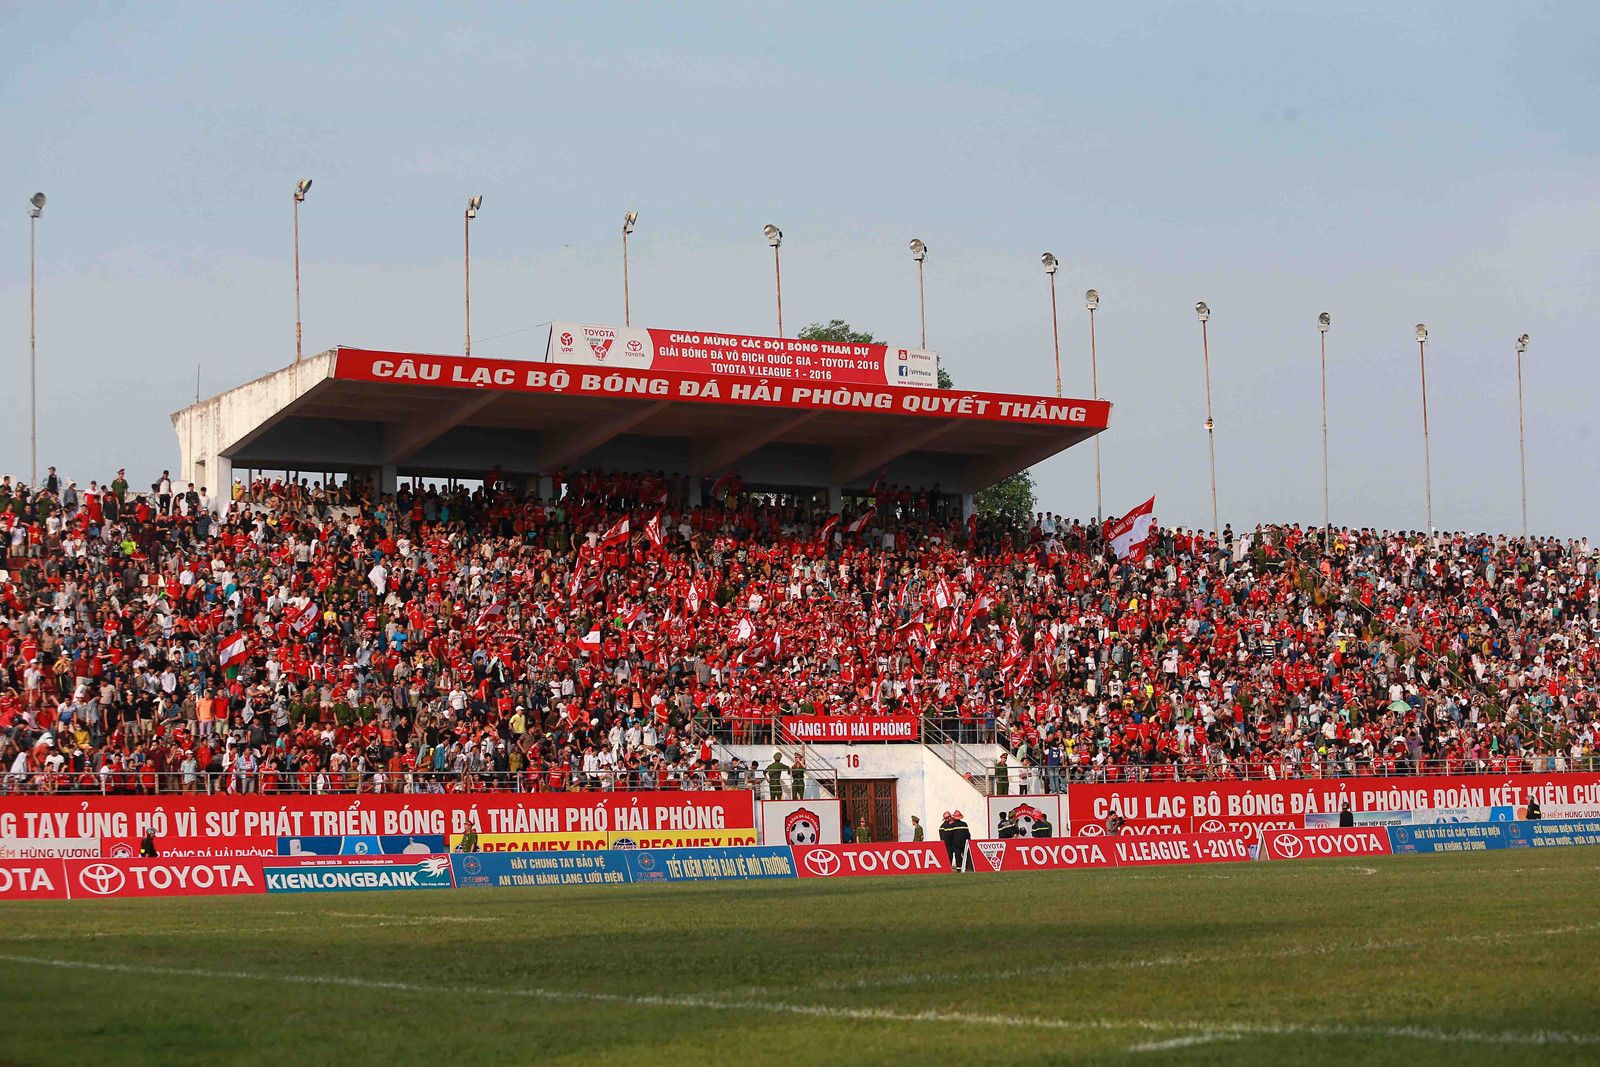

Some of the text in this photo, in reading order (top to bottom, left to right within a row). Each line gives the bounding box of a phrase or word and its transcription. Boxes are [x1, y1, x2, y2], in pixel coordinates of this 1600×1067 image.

[584, 329, 615, 337] TOYOTA
[670, 333, 870, 358] CHÀO MỪNG CÁC ĐỘI BÓNG THAM DỰ
[660, 345, 678, 357] GIẢI
[682, 347, 707, 359] BÓNG
[710, 349, 723, 360] ĐÁ
[726, 350, 738, 361] VÔ
[741, 352, 764, 363] ĐỊCH
[767, 352, 793, 365] QUỐC
[796, 356, 811, 366] GIA
[821, 358, 855, 369] TOYOTA
[857, 360, 880, 371] 2016
[711, 362, 746, 375] TOYOTA
[748, 366, 792, 378] V.LEAGUE
[795, 369, 799, 378] 1
[810, 370, 832, 380] 2016
[371, 359, 1087, 422] CÂU LẠC BỘ BÓNG ĐÁ HẢI PHÒNG QUYẾT THẮNG
[829, 721, 847, 736] TÔI
[851, 717, 869, 736] HẢI
[873, 719, 911, 736] PHÒNG
[846, 754, 860, 768] 16
[1093, 792, 1138, 819] CÂU
[1228, 790, 1285, 817] BÓNG
[1290, 788, 1318, 815] ĐÁ
[1323, 783, 1357, 813] HẢI
[1363, 785, 1428, 811] PHÒNG
[1433, 784, 1485, 809] ĐOÀN
[1490, 780, 1522, 807] KẾT
[1527, 782, 1568, 806] KIÊN
[24, 812, 69, 838] TAY
[77, 801, 128, 838] ỦNG
[175, 806, 198, 837] VÌ
[244, 806, 303, 836] PHÁT
[310, 800, 377, 836] TRIỂN
[384, 805, 445, 835] BÓNG
[451, 804, 482, 834] ĐÁ
[488, 803, 559, 833] THÀNH
[566, 799, 609, 832] PHỐ
[614, 797, 648, 831] HẢI
[656, 800, 725, 830] PHÒNG
[20, 847, 54, 858] HÙNG
[58, 848, 99, 858] VƯƠNG
[1115, 838, 1247, 862] V.LEAGUE 1-2016
[1304, 834, 1384, 854] TOYOTA
[511, 853, 606, 870] HÃY CHUNG TAY BẢO VỆ
[666, 853, 684, 878] TIẾT
[682, 855, 704, 881] KIỆM
[720, 850, 737, 877] BẢO
[736, 854, 748, 880] VỆ
[745, 853, 763, 876] MÔI
[761, 852, 791, 875] TRƯỜNG
[843, 849, 942, 871] TOYOTA
[1016, 845, 1107, 866] TOYOTA
[129, 865, 254, 889] TOYOTA
[266, 871, 421, 890] KIENLONGBANK
[499, 875, 511, 886] AN
[512, 874, 535, 885] TOÀN
[536, 873, 560, 884] HÀNH
[561, 873, 583, 884] LANG
